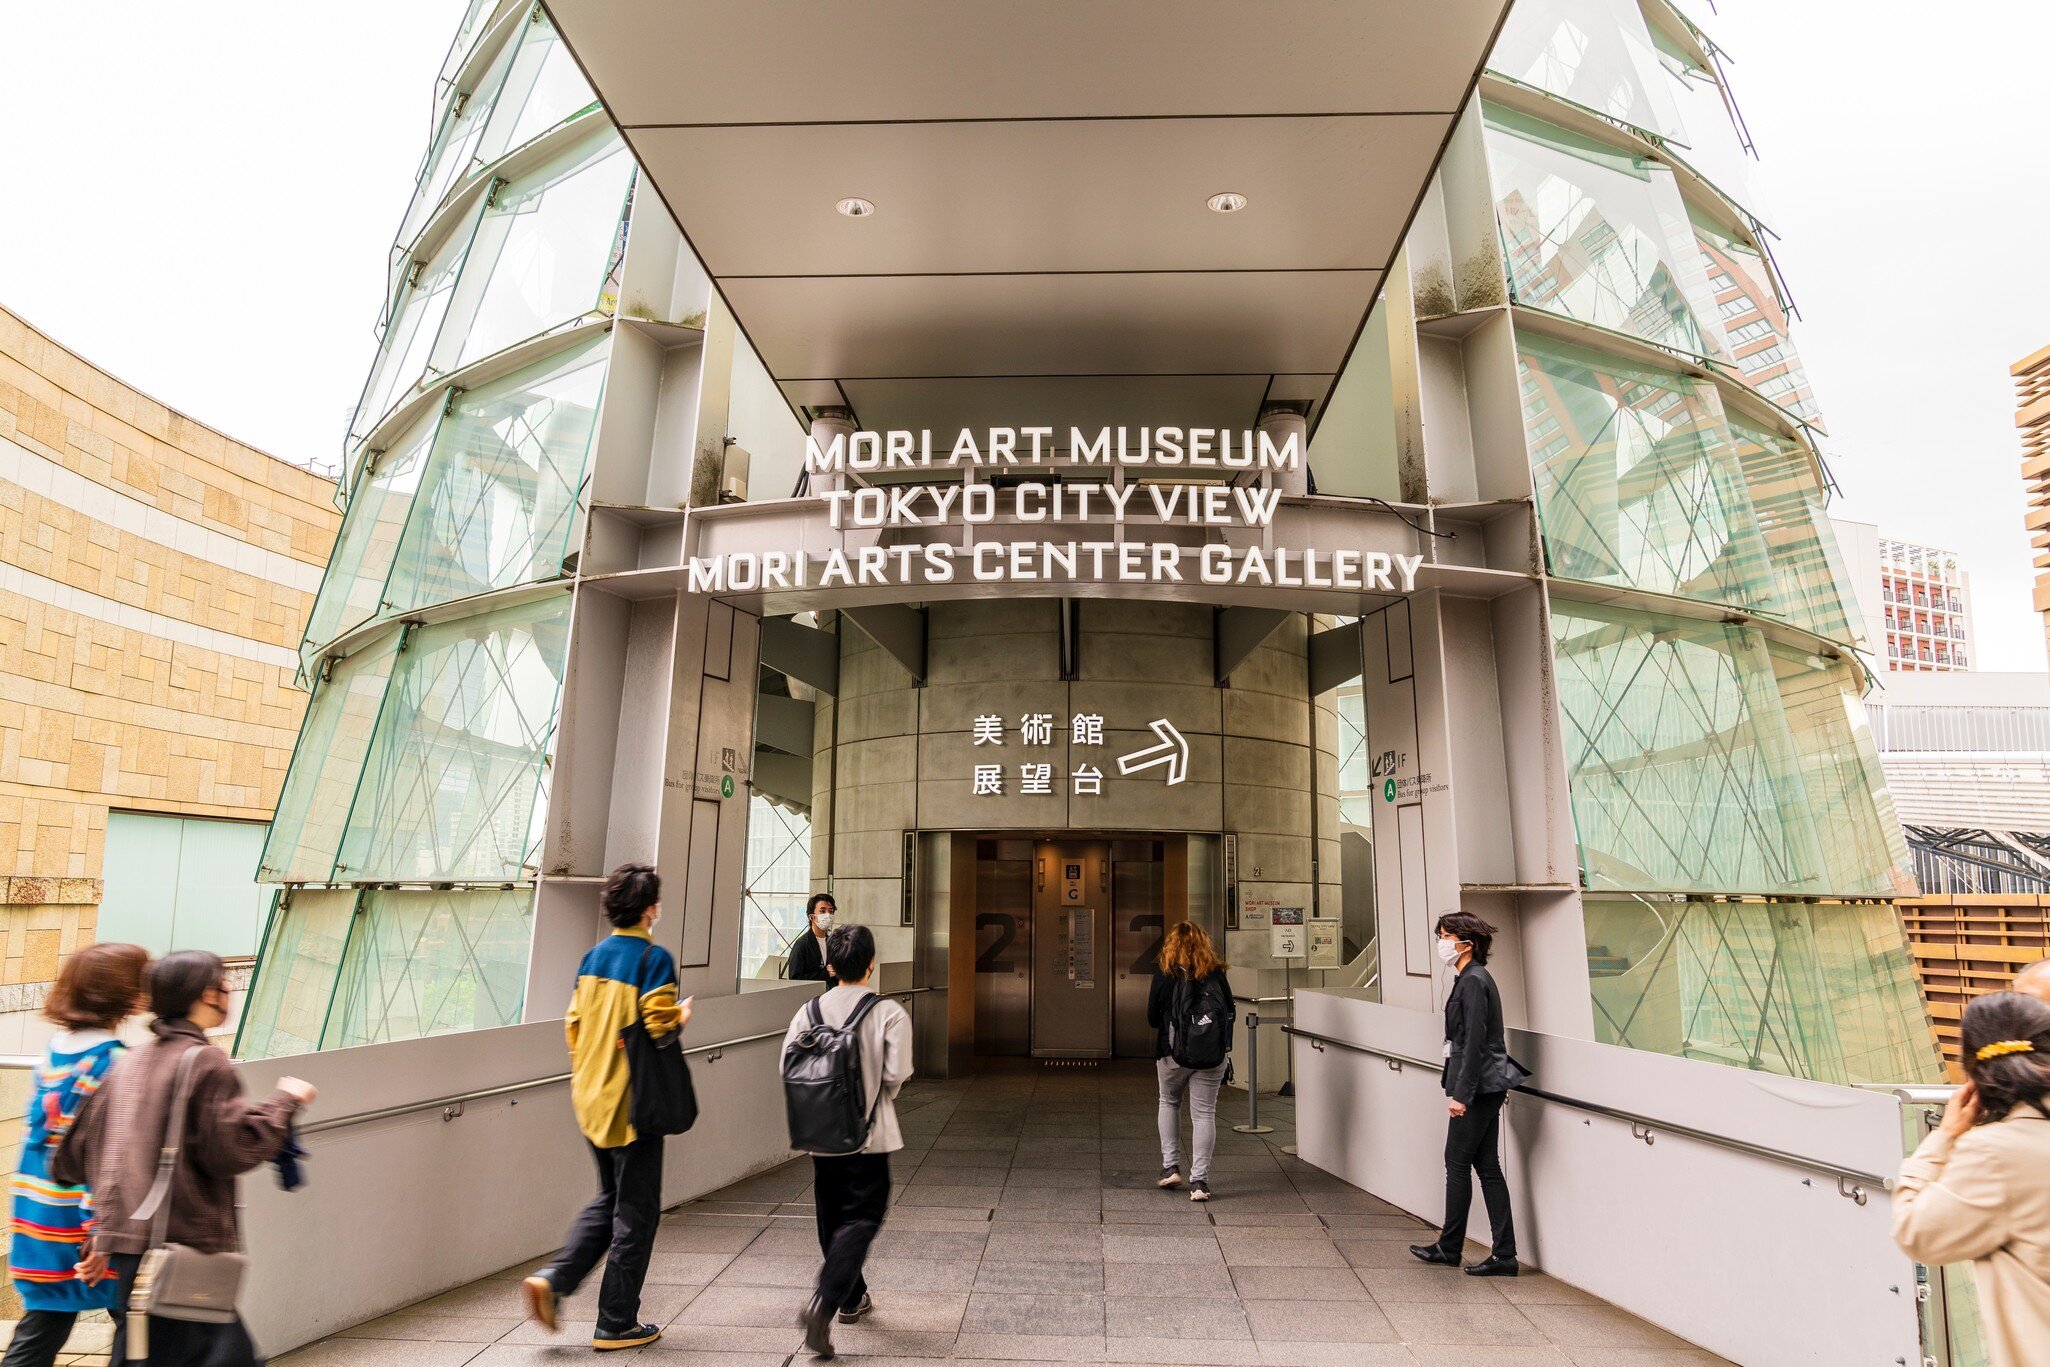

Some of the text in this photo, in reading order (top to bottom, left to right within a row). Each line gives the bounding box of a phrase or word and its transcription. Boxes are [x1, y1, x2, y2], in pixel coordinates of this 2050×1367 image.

[805, 426, 1299, 474] MORI ART MUSEUM
[820, 482, 1283, 530] TOKYO CITY VIEW
[688, 541, 1425, 594] MORI ARTS CENTER GALLERY
[973, 713, 1104, 746] 美術館
[973, 763, 1104, 795] 展望台
[1397, 790, 1406, 799] Bus
[1430, 784, 1449, 793] visitors
[1068, 889, 1079, 900] G
[975, 912, 1017, 973] 2
